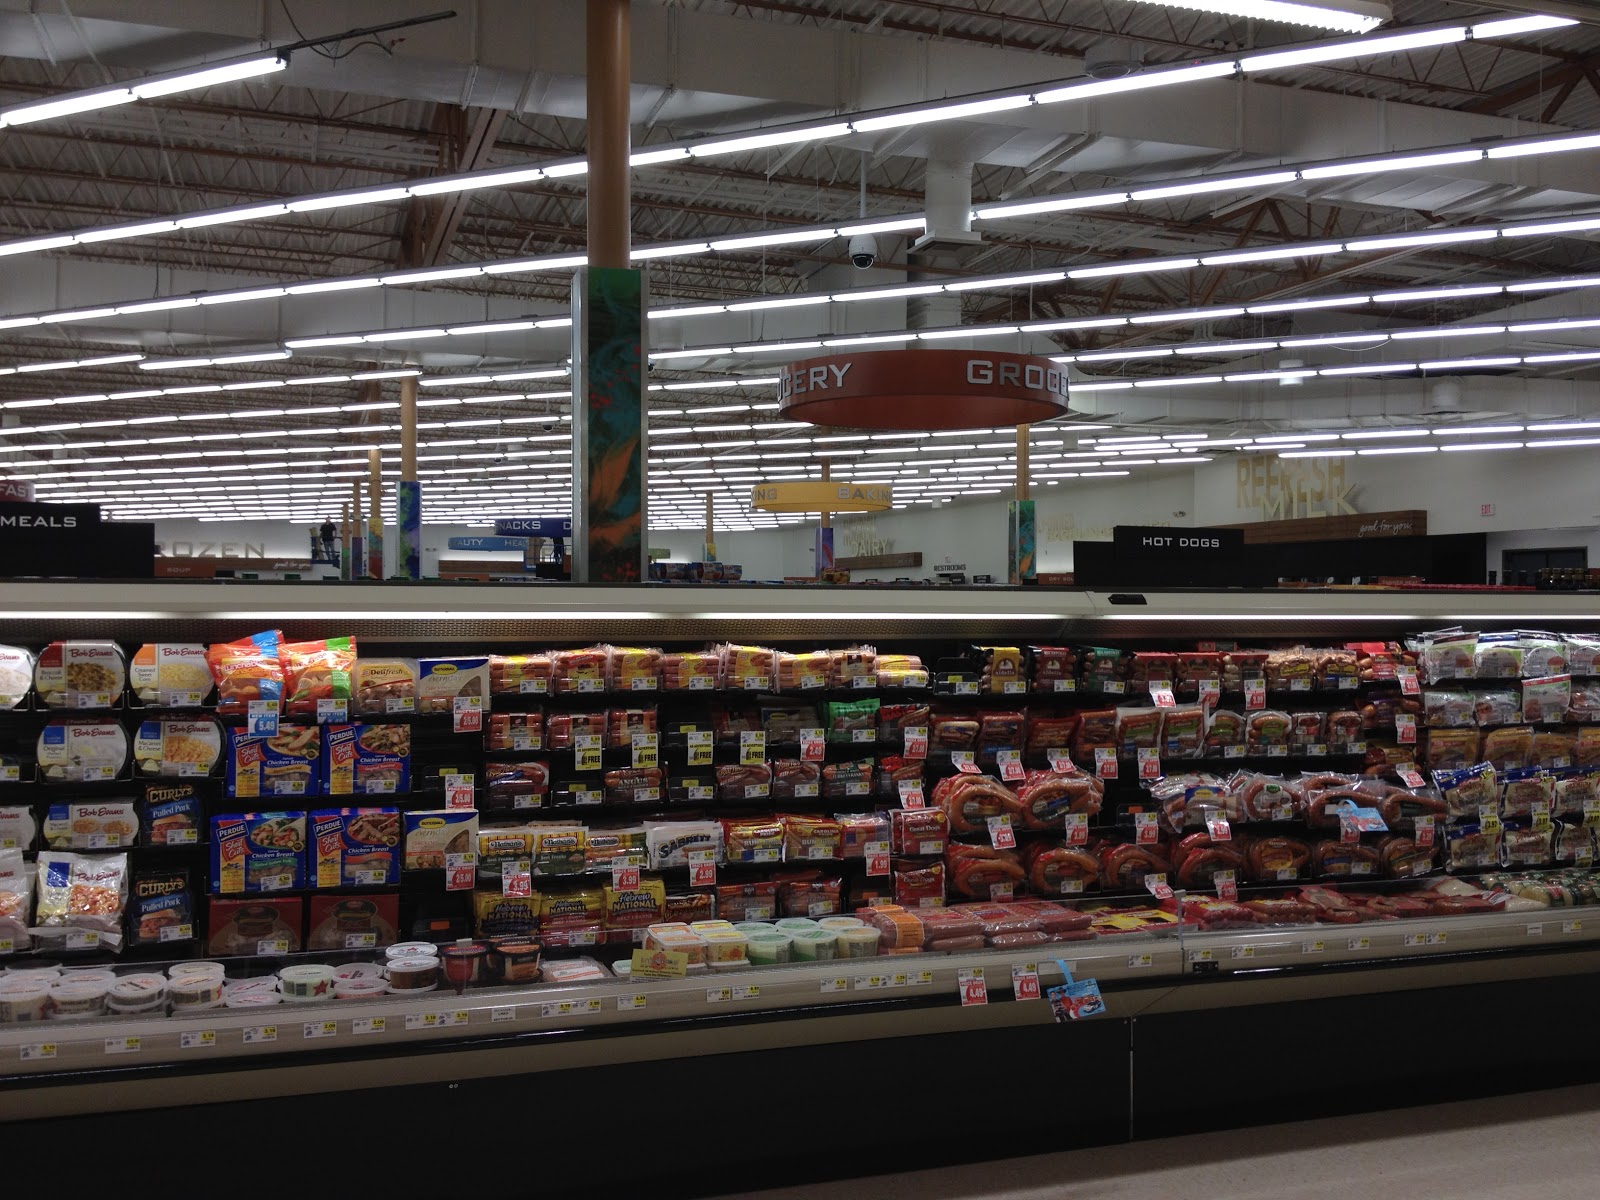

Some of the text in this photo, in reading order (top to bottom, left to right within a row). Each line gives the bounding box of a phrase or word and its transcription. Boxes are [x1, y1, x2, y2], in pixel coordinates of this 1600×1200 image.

[1260, 482, 1360, 522] MILK
[0, 515, 77, 528] MEALS
[1358, 519, 1379, 537] good
[1379, 519, 1392, 532] for
[1142, 536, 1220, 548] HOT DOGS
[851, 538, 889, 557] DAIRY
[166, 566, 191, 574] SOUP
[933, 563, 967, 572] RESTROOMS
[69, 648, 114, 658] Bob Evans
[162, 647, 204, 657] Bob Evans
[167, 724, 211, 734] Bob Evans
[259, 721, 275, 731] 5.49
[72, 728, 116, 738] Bob Evans
[329, 730, 355, 742] PERDUE
[587, 755, 601, 764] FREE
[644, 754, 657, 762] FREE
[699, 751, 712, 760] FREE
[751, 751, 764, 759] FREE
[617, 776, 649, 786] ANGUS
[149, 785, 193, 803] CURLY'S
[76, 807, 125, 818] Bob Evans
[152, 803, 191, 818] Pulled Pork
[218, 824, 246, 838] PERDUE
[315, 819, 342, 833] PERDUE
[925, 825, 941, 833] Dogs
[658, 834, 712, 859] SABRETT
[801, 838, 816, 846] BUN
[875, 859, 887, 868] 1.99
[699, 869, 713, 880] 2.99
[622, 875, 637, 885] 3.99
[139, 881, 185, 897] CURLY'S
[512, 881, 529, 891] 3.99
[619, 891, 651, 902] Hebrew
[141, 898, 181, 913] Pulled Pork
[495, 903, 528, 914] Hebrew
[554, 899, 583, 908] Hebrew
[612, 898, 657, 912] NATIONAL
[550, 905, 588, 914] NATIONAL
[487, 911, 533, 920] NATIONAL
[1022, 982, 1037, 993] 4.49
[969, 988, 983, 998] 4.49
